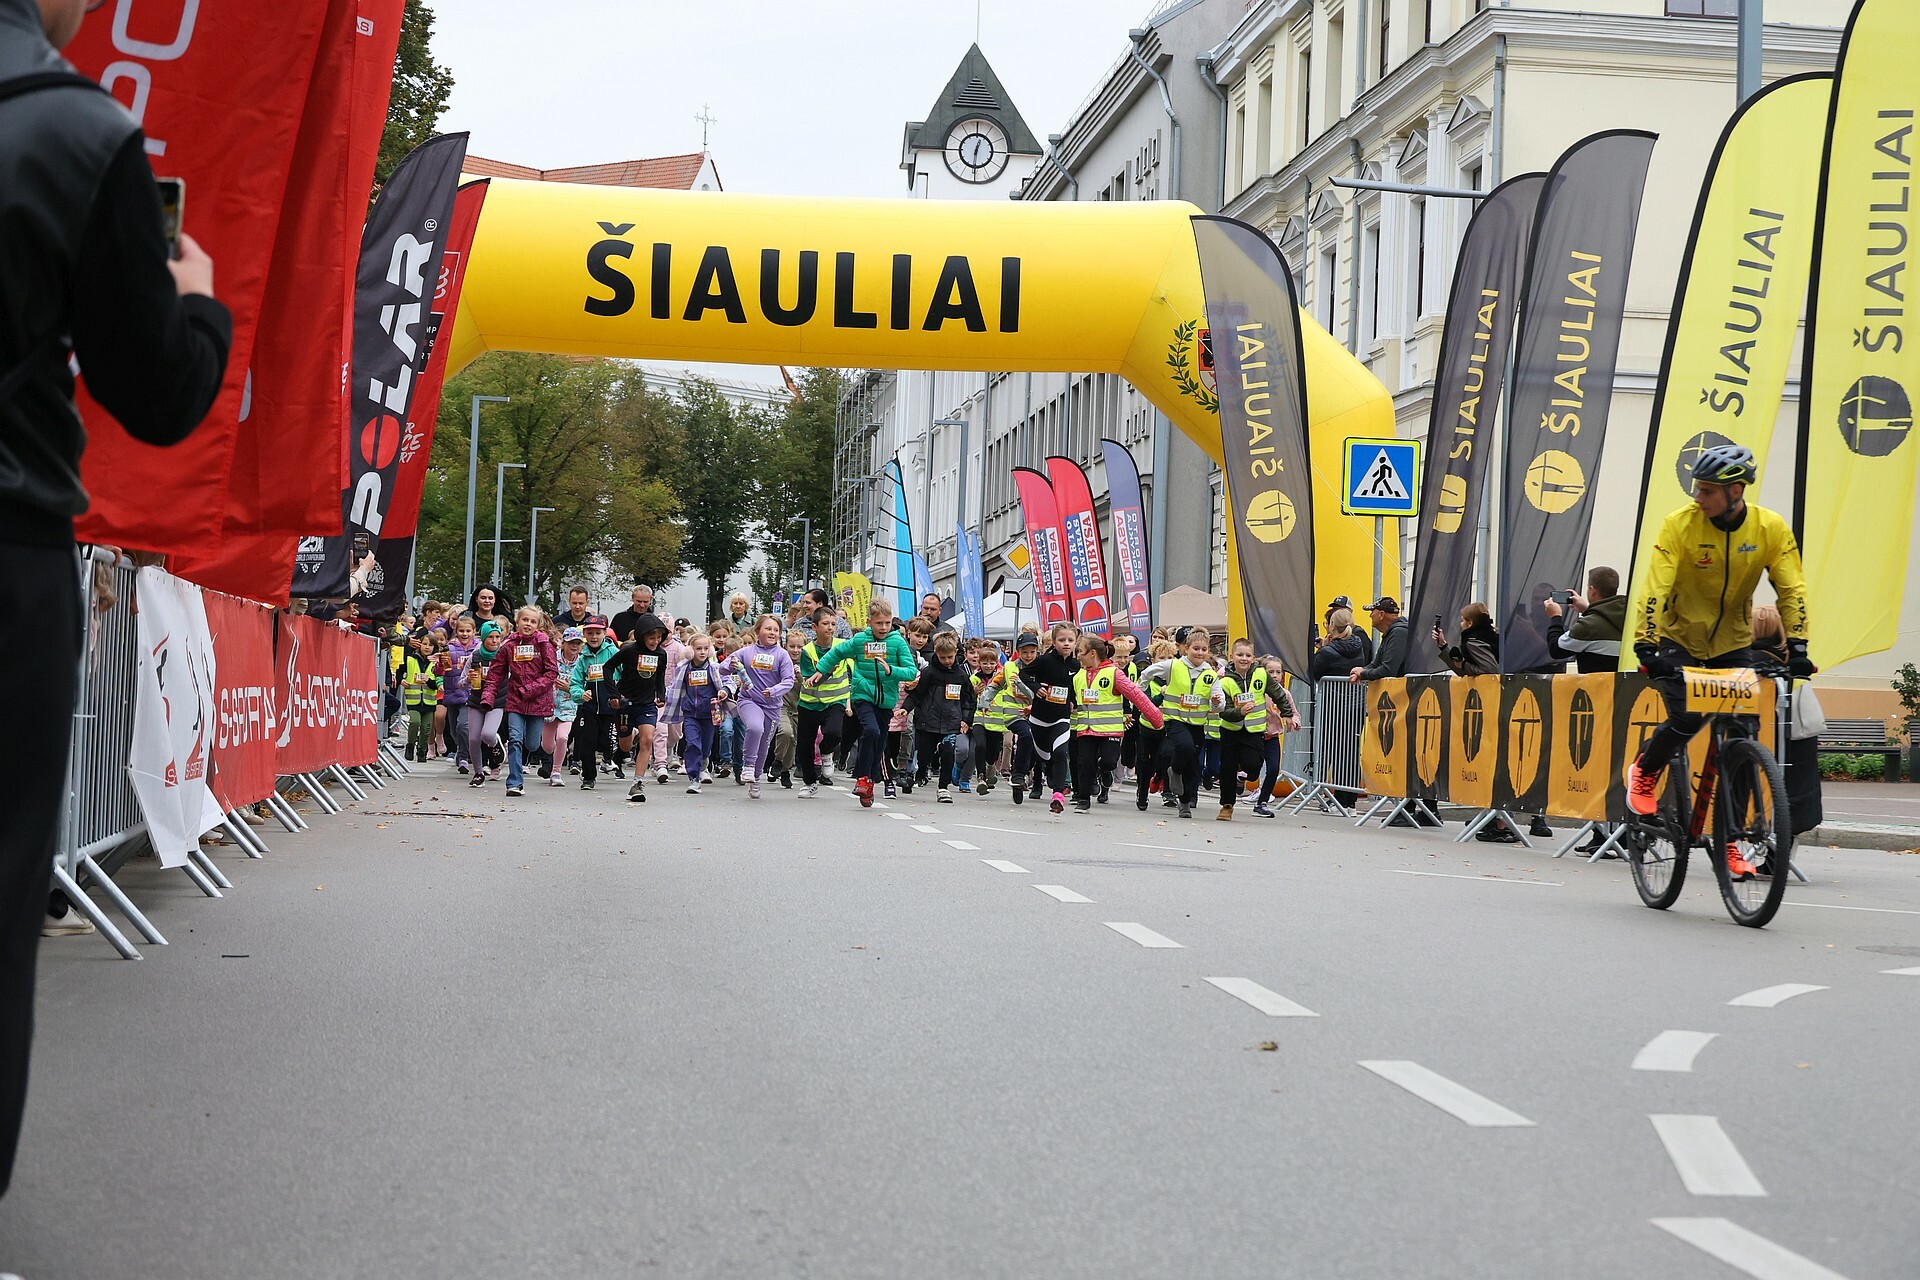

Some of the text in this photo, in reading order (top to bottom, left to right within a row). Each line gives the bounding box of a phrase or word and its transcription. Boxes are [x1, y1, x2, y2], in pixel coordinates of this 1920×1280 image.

[1853, 109, 1914, 354] ŠIAULIAI
[584, 221, 1021, 333] ŠIAULIAI
[1540, 250, 1602, 437] ŠIAULIAI
[1700, 207, 1785, 418] ŠIAULIAI
[1049, 531, 1062, 592] DUBYSA
[1066, 520, 1083, 588] SPORTO
[1072, 518, 1089, 586] CENTRAS
[1082, 515, 1101, 585] DUBYSA
[517, 645, 533, 653] 1236
[868, 642, 886, 651] 1236
[1238, 693, 1254, 701] 1236
[1693, 679, 1752, 699] LYDERIS
